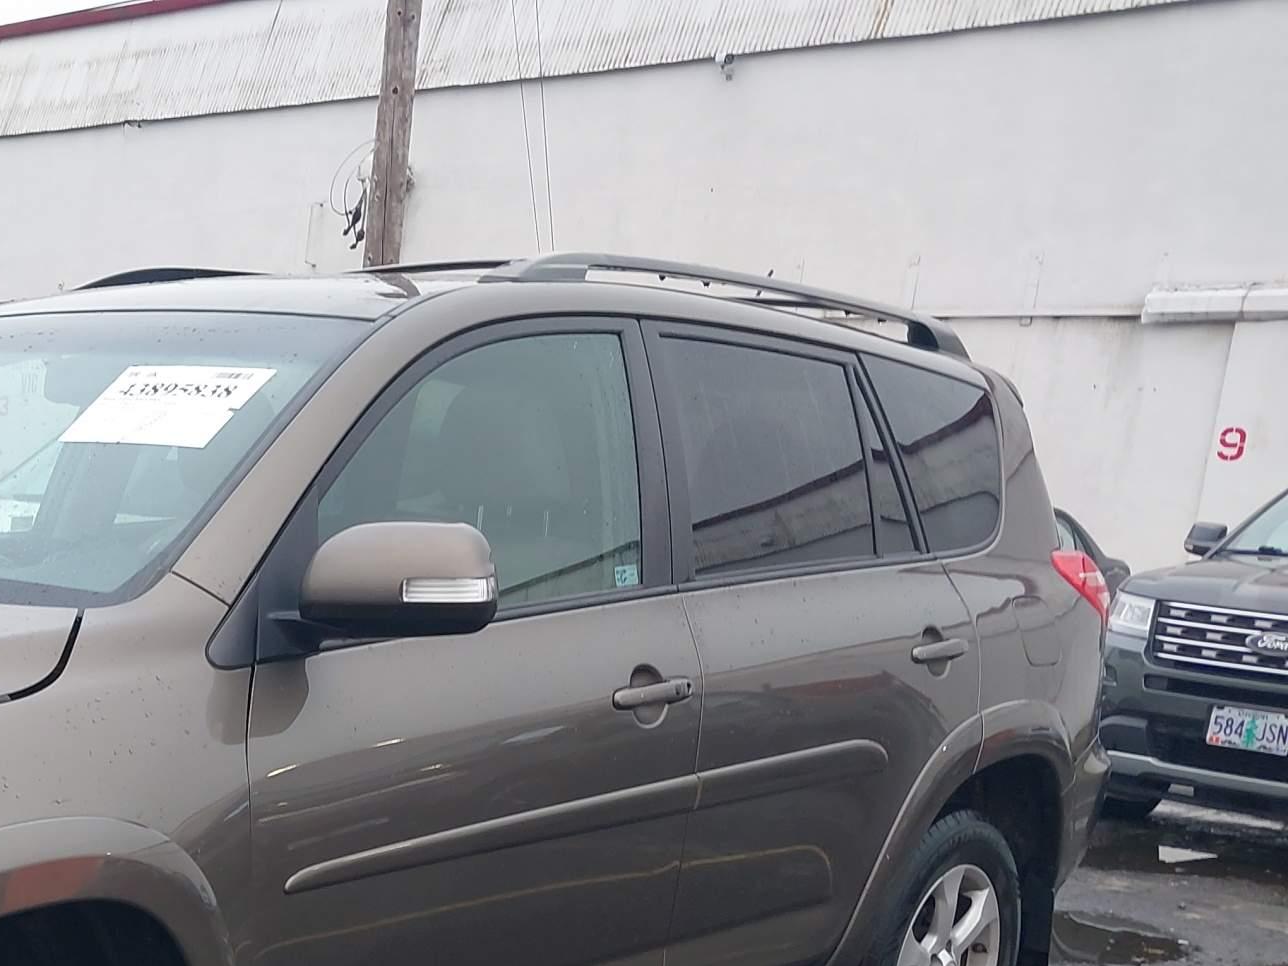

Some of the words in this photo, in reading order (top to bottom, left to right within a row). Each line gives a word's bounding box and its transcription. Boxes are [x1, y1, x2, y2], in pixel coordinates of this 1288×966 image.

[1216, 426, 1247, 461] 9
[1212, 715, 1245, 739] 584
[1255, 722, 1288, 747] JSN
